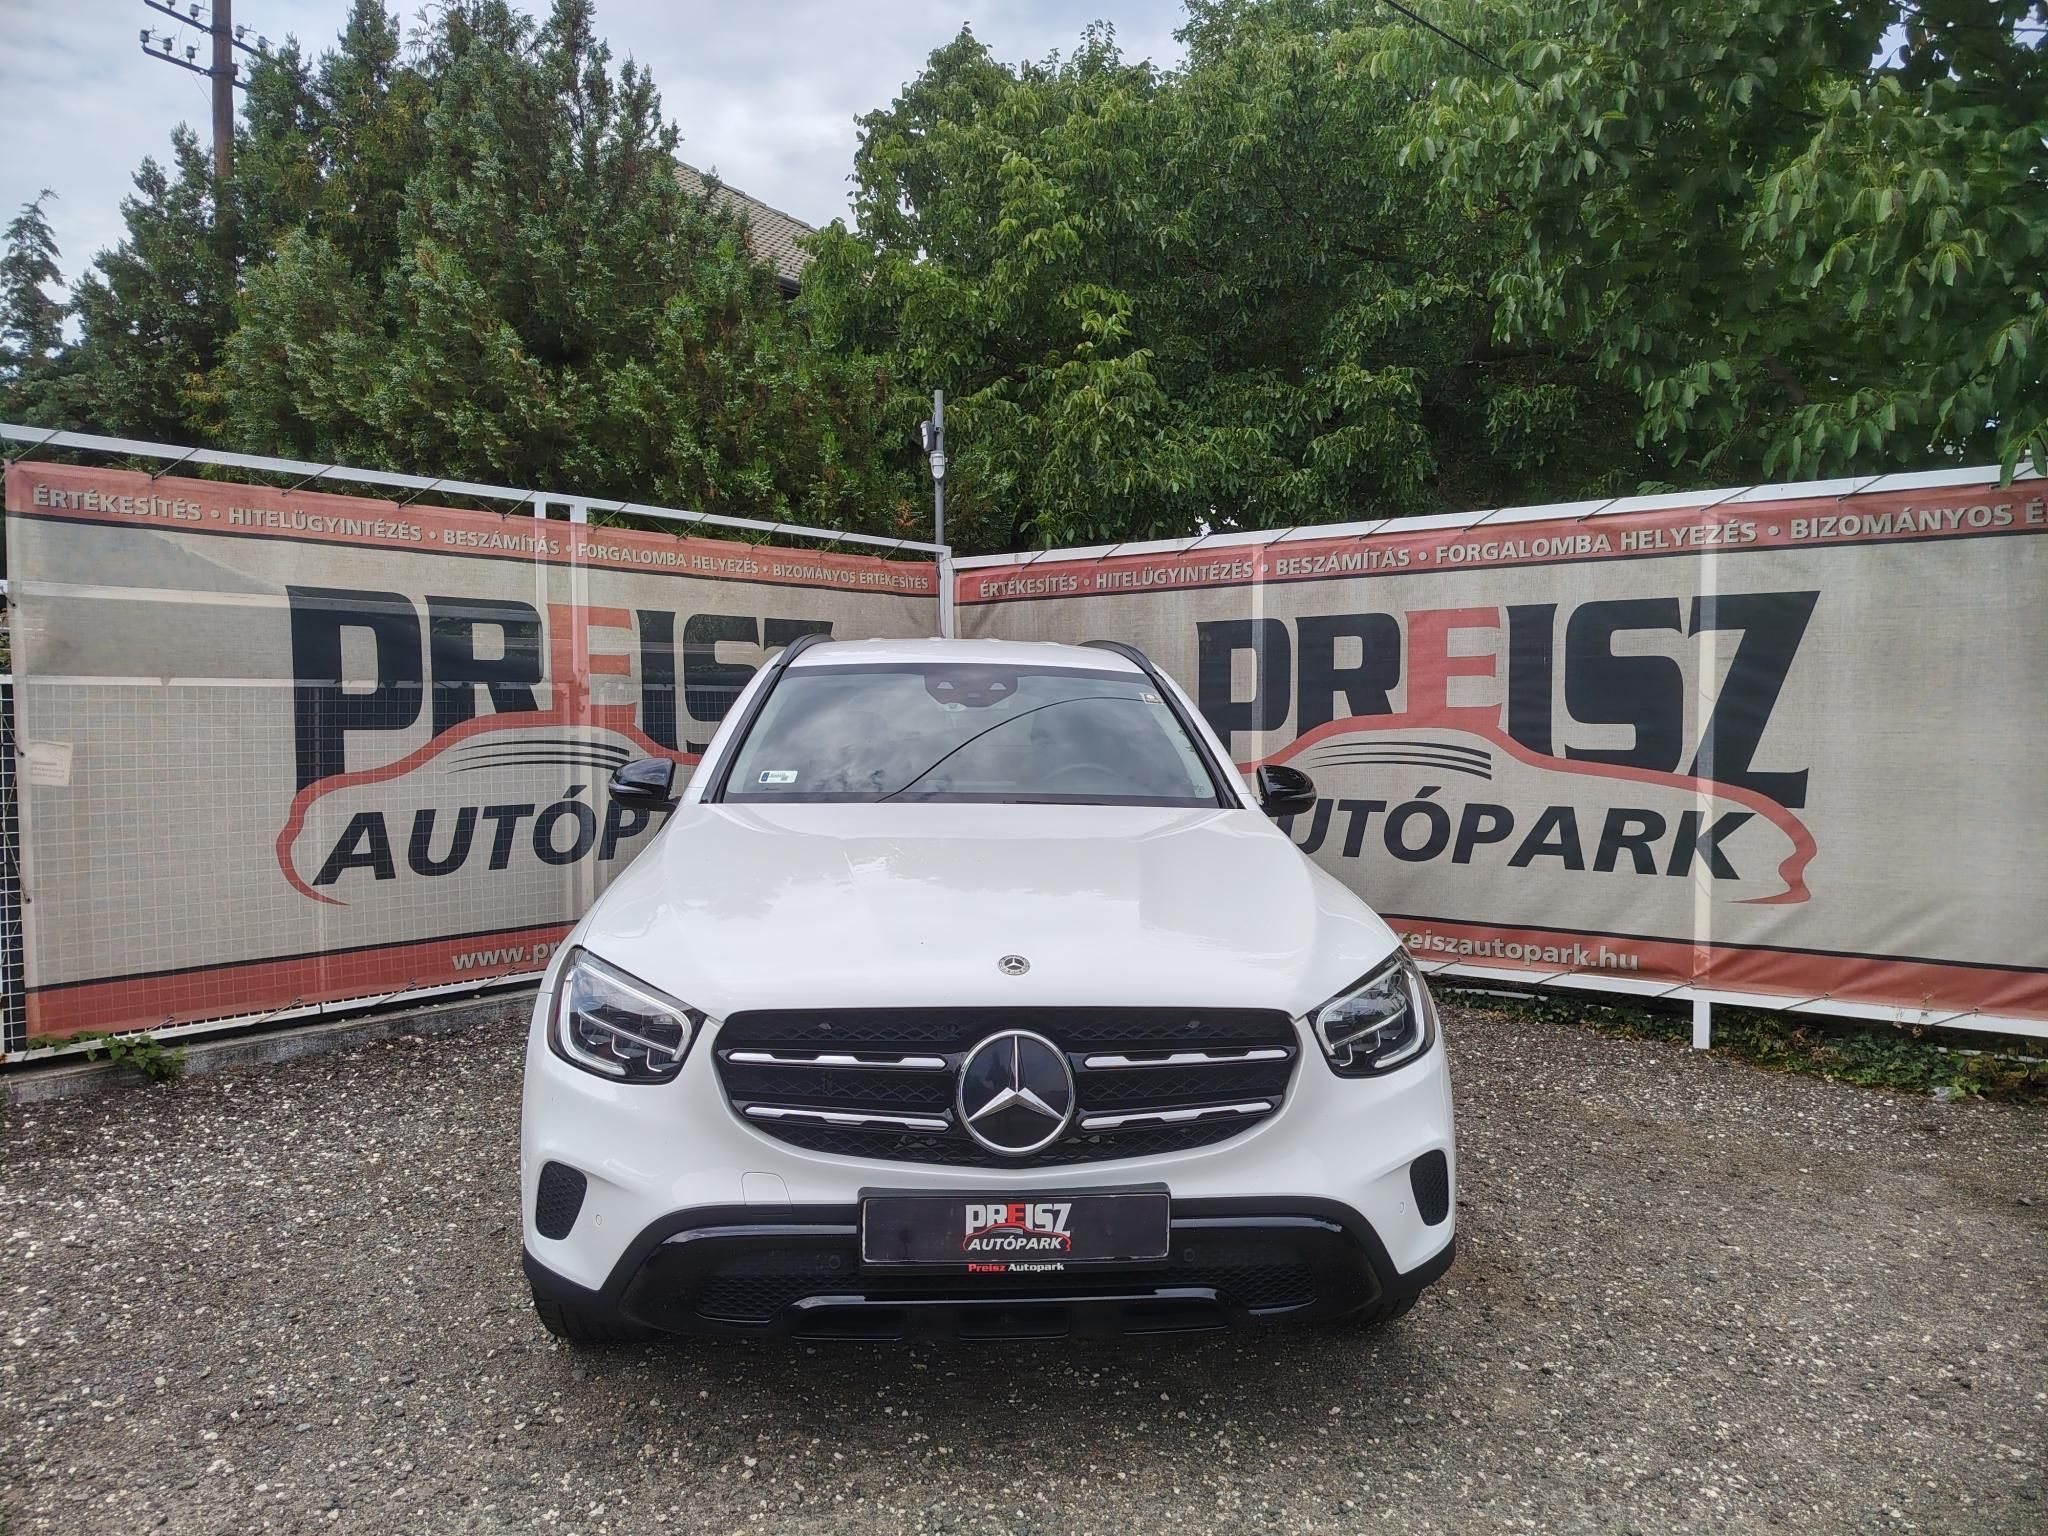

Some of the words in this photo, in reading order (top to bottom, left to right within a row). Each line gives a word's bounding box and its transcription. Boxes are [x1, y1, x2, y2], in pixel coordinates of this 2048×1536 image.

[33, 484, 202, 521] ÉRTÉKESÍTÉS
[229, 507, 423, 542] HITELÜGYINTÉZÉS
[444, 528, 561, 556] BESZÁMÍTÁS
[578, 543, 688, 569] FORGALOMBA
[691, 554, 760, 575] HELYEZÉS
[774, 564, 857, 584] BIZOMÁNYOS
[860, 569, 930, 589] ÉRTÉKESÍTÉS
[979, 574, 1078, 598] ÉRTÉKESÍTÉS
[1096, 559, 1253, 589] HITELÜGYINTÉZÉS
[1276, 547, 1410, 575] BESZÁMÍTÁS
[1436, 536, 1611, 563] FORGALOMBA
[1620, 522, 1757, 551] HELYEZÉS
[1790, 503, 2014, 540] BIZOMÁNYOS
[1196, 590, 1821, 808] PREISZ
[312, 786, 668, 886] AUTÓP
[965, 1203, 1072, 1237] PREISZ
[967, 1235, 1063, 1251] AUTÓPARK
[968, 1263, 1005, 1273] Preisz
[1008, 1262, 1065, 1272] Autopark
